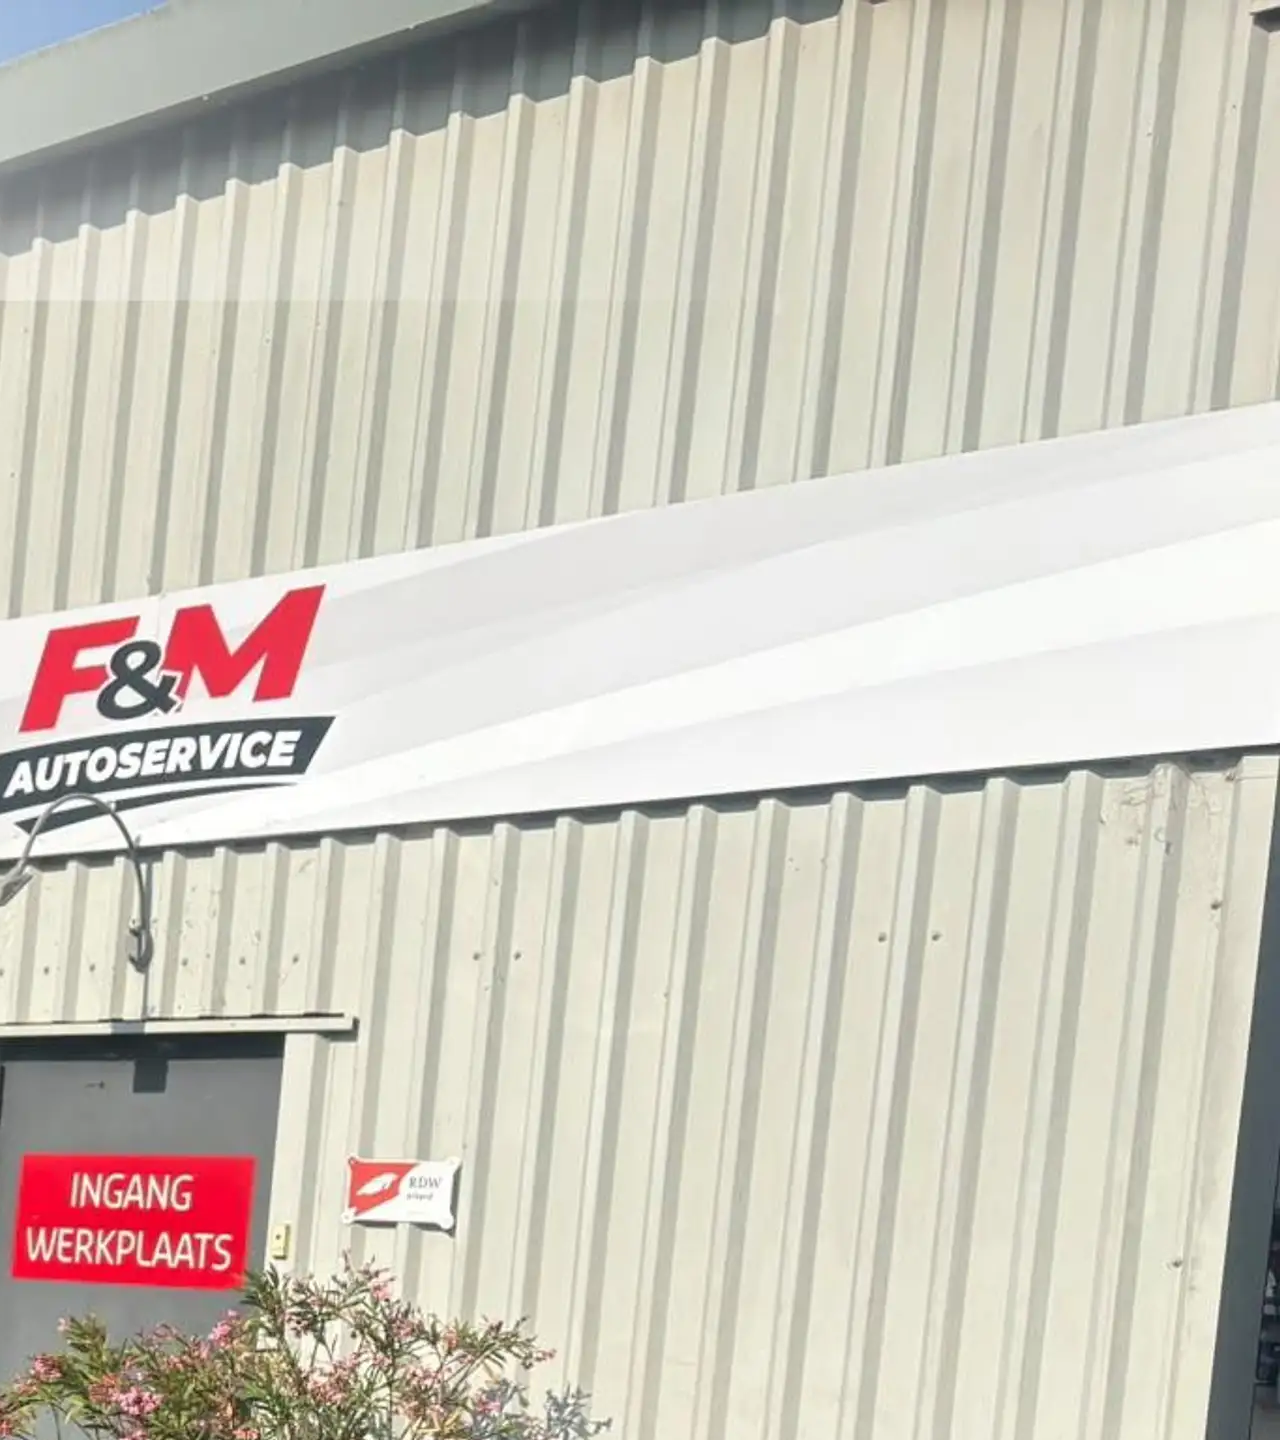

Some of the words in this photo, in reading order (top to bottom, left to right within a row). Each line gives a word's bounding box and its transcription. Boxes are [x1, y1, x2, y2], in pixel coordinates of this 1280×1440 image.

[19, 584, 326, 733] F&M
[2, 730, 303, 798] AUTOSERVICE
[70, 1172, 194, 1211] INGANG
[26, 1226, 233, 1271] WERKPLAATS
